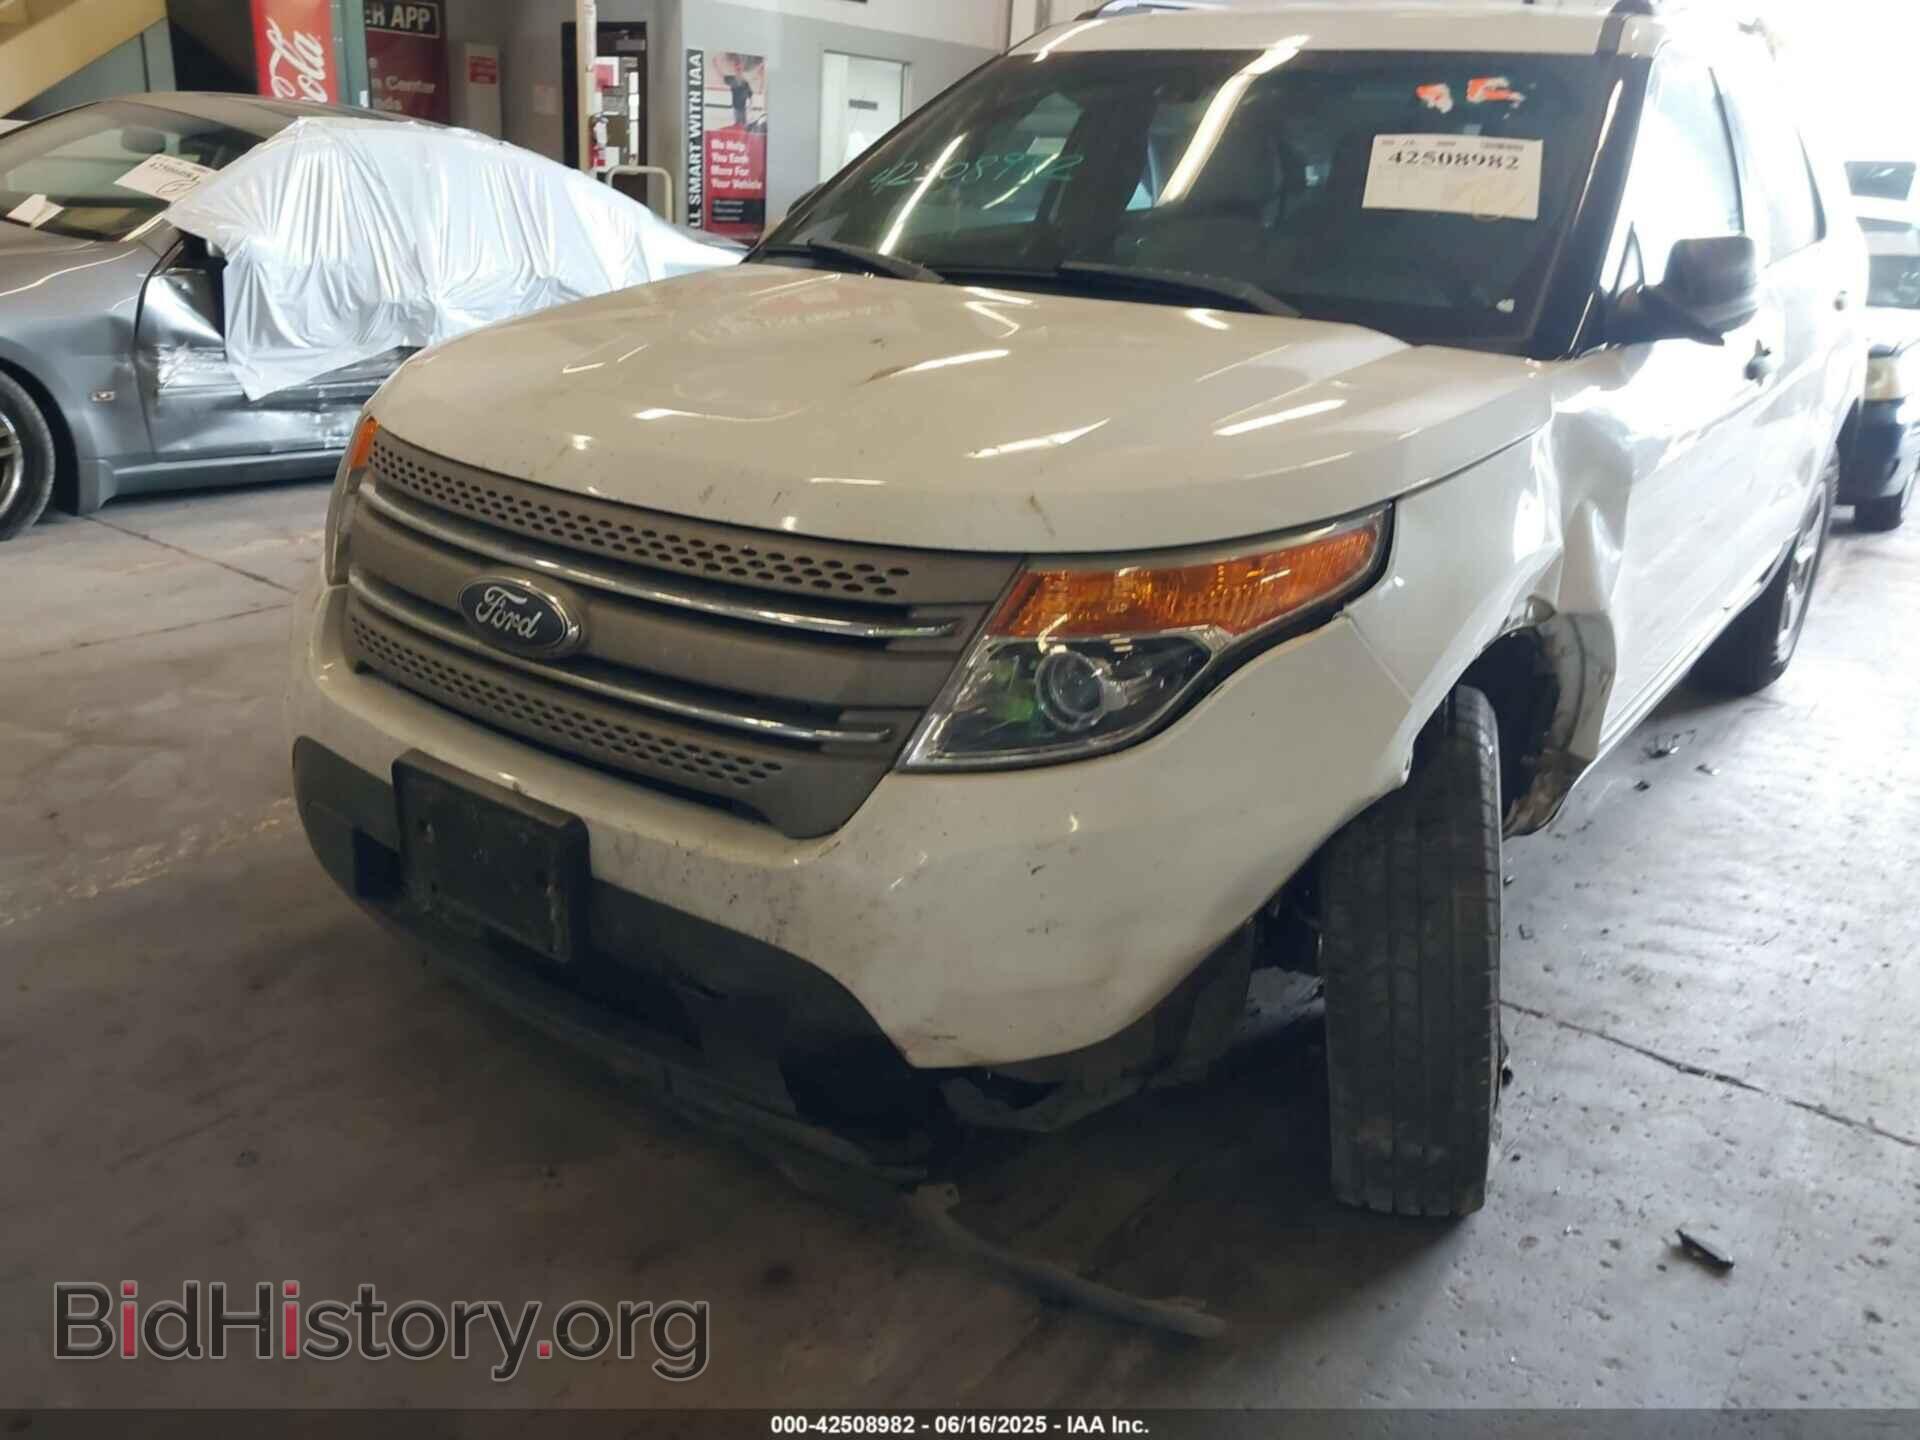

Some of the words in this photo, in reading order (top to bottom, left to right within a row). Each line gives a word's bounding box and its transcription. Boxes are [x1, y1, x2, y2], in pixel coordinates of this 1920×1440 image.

[390, 5, 430, 31] APP
[689, 53, 702, 86] IAA
[689, 92, 702, 139] WITH
[689, 141, 702, 205] SMART
[1387, 150, 1520, 171] 42508982
[475, 585, 543, 639] Ford
